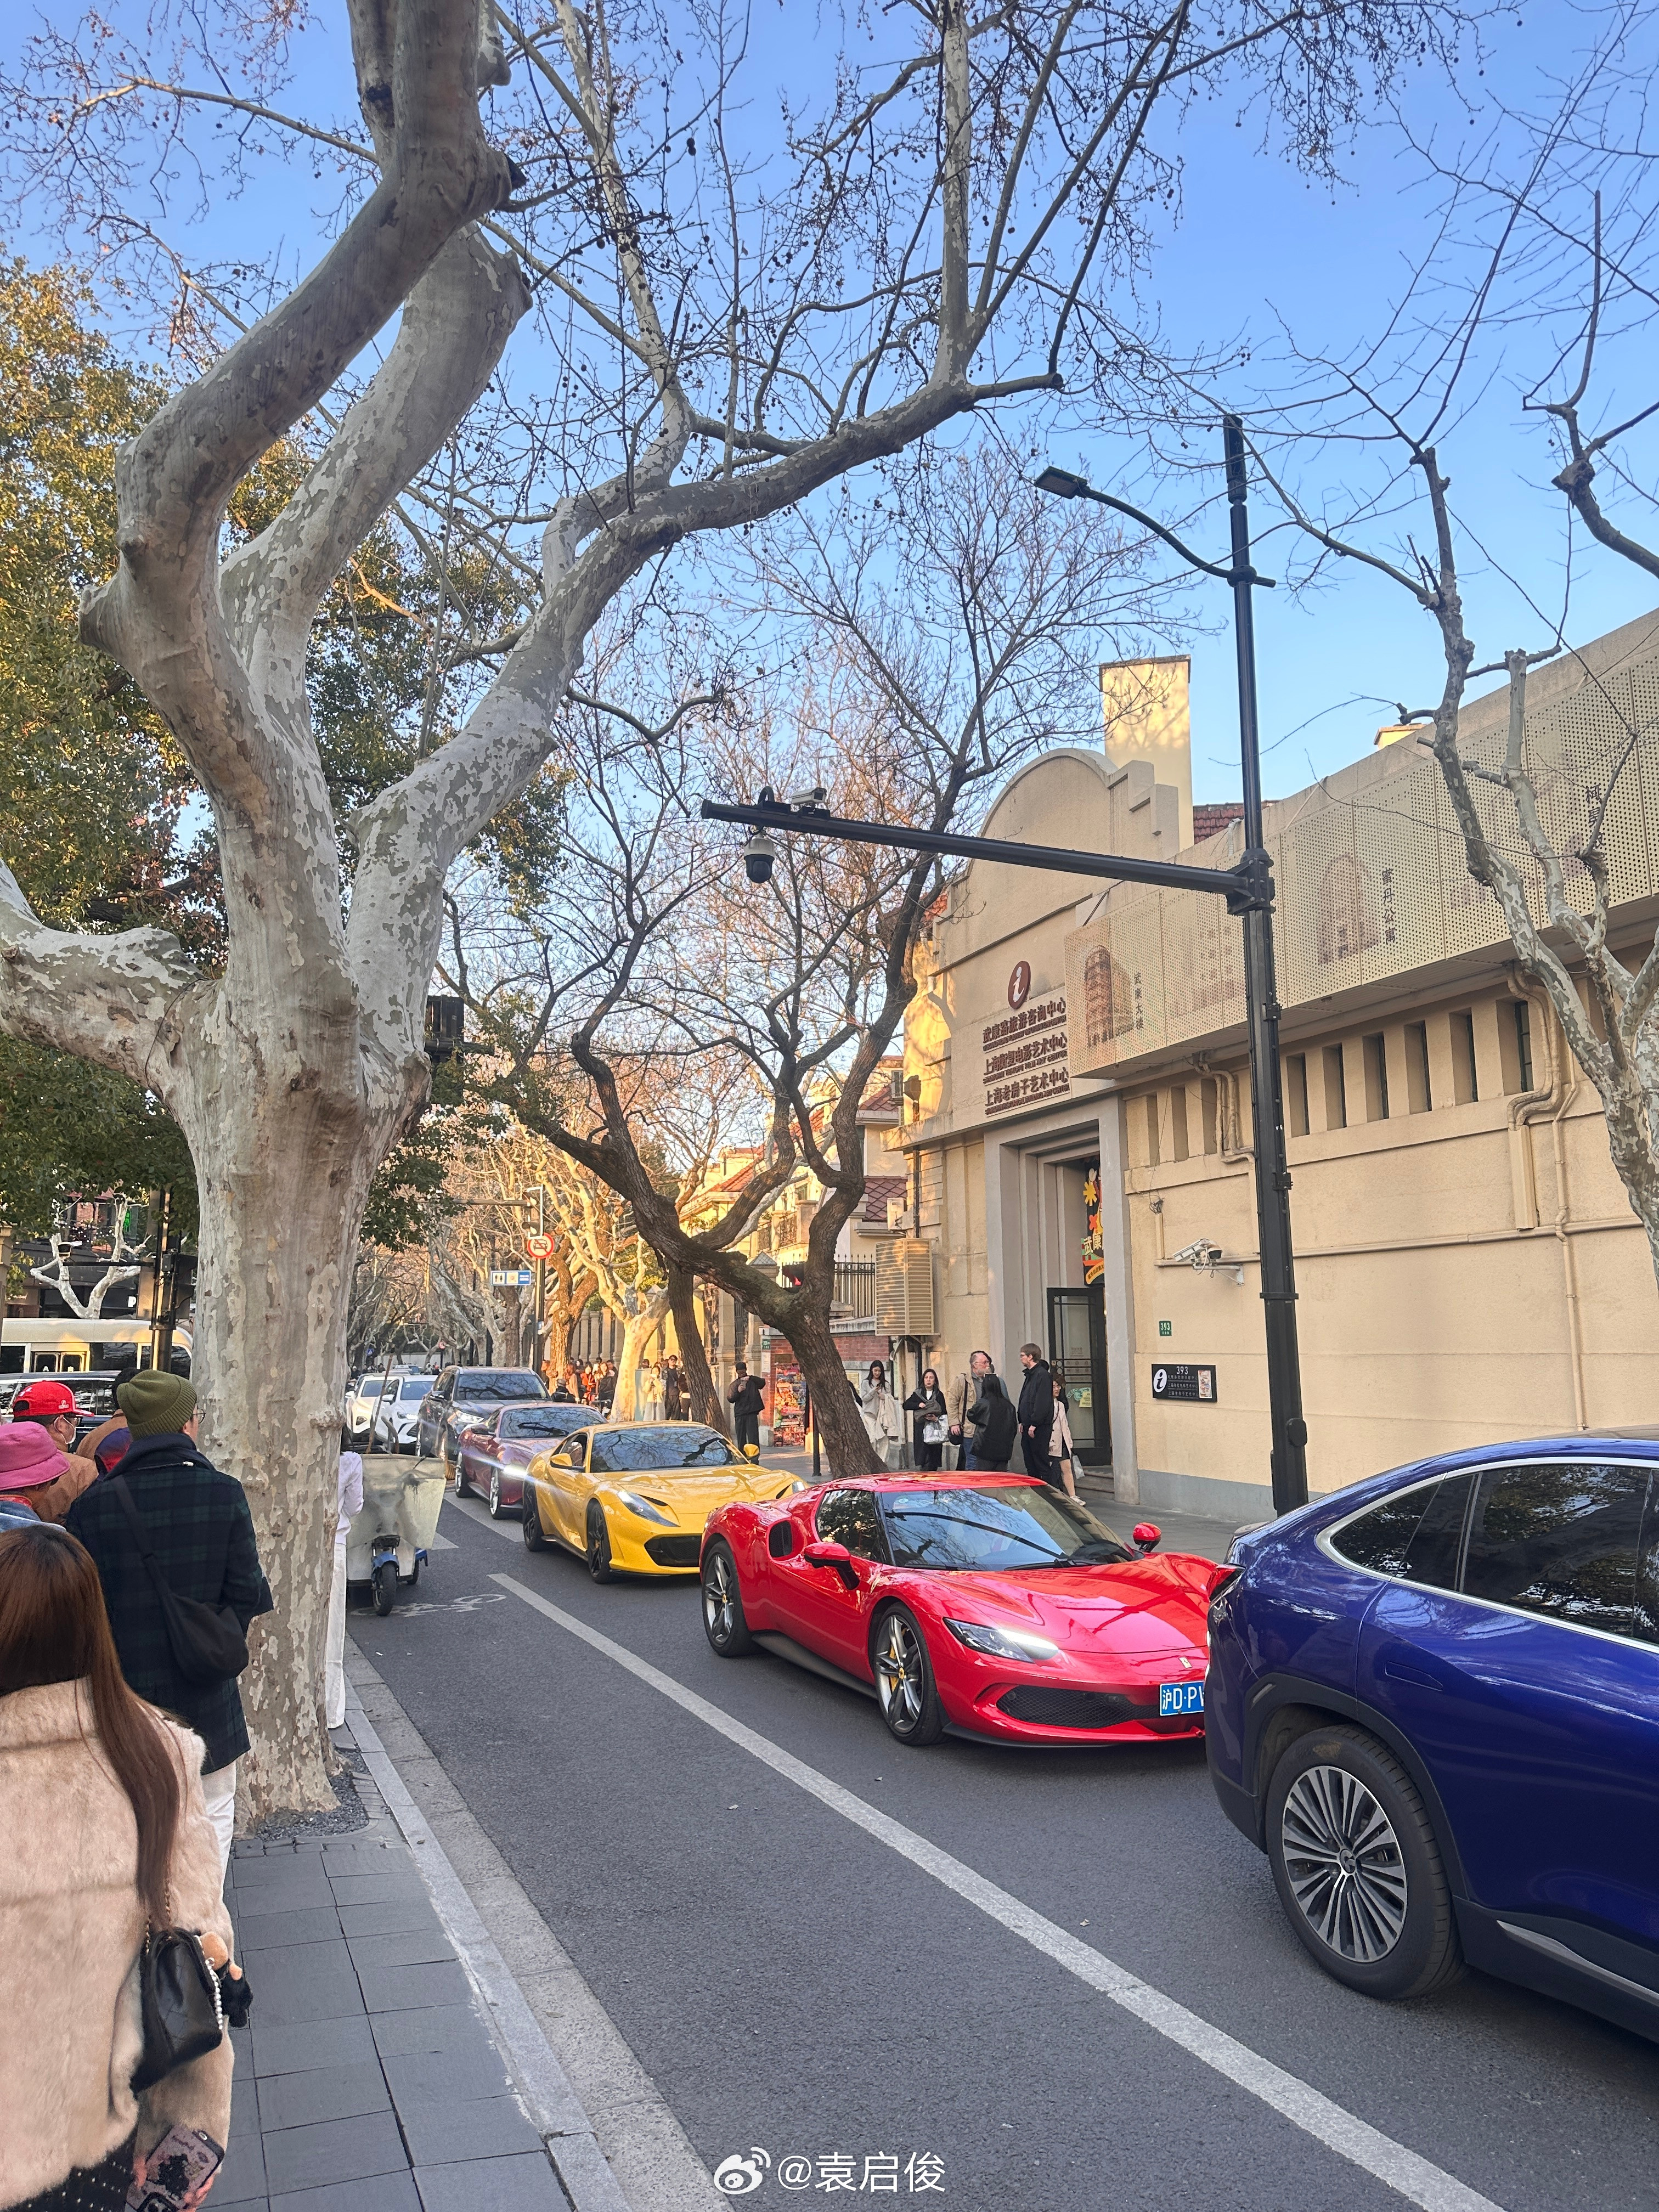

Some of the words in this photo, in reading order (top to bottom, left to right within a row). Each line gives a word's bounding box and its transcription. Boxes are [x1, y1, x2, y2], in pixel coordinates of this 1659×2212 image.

[983, 997, 1066, 1043] 武康路旅游咨询中心
[984, 1032, 1068, 1075] 上海衡复电影艺术中心
[985, 1066, 1069, 1107] 上海老房子艺术中心
[1084, 1234, 1104, 1255] 武康
[1160, 1322, 1170, 1331] 393
[1176, 1366, 1188, 1375] 393
